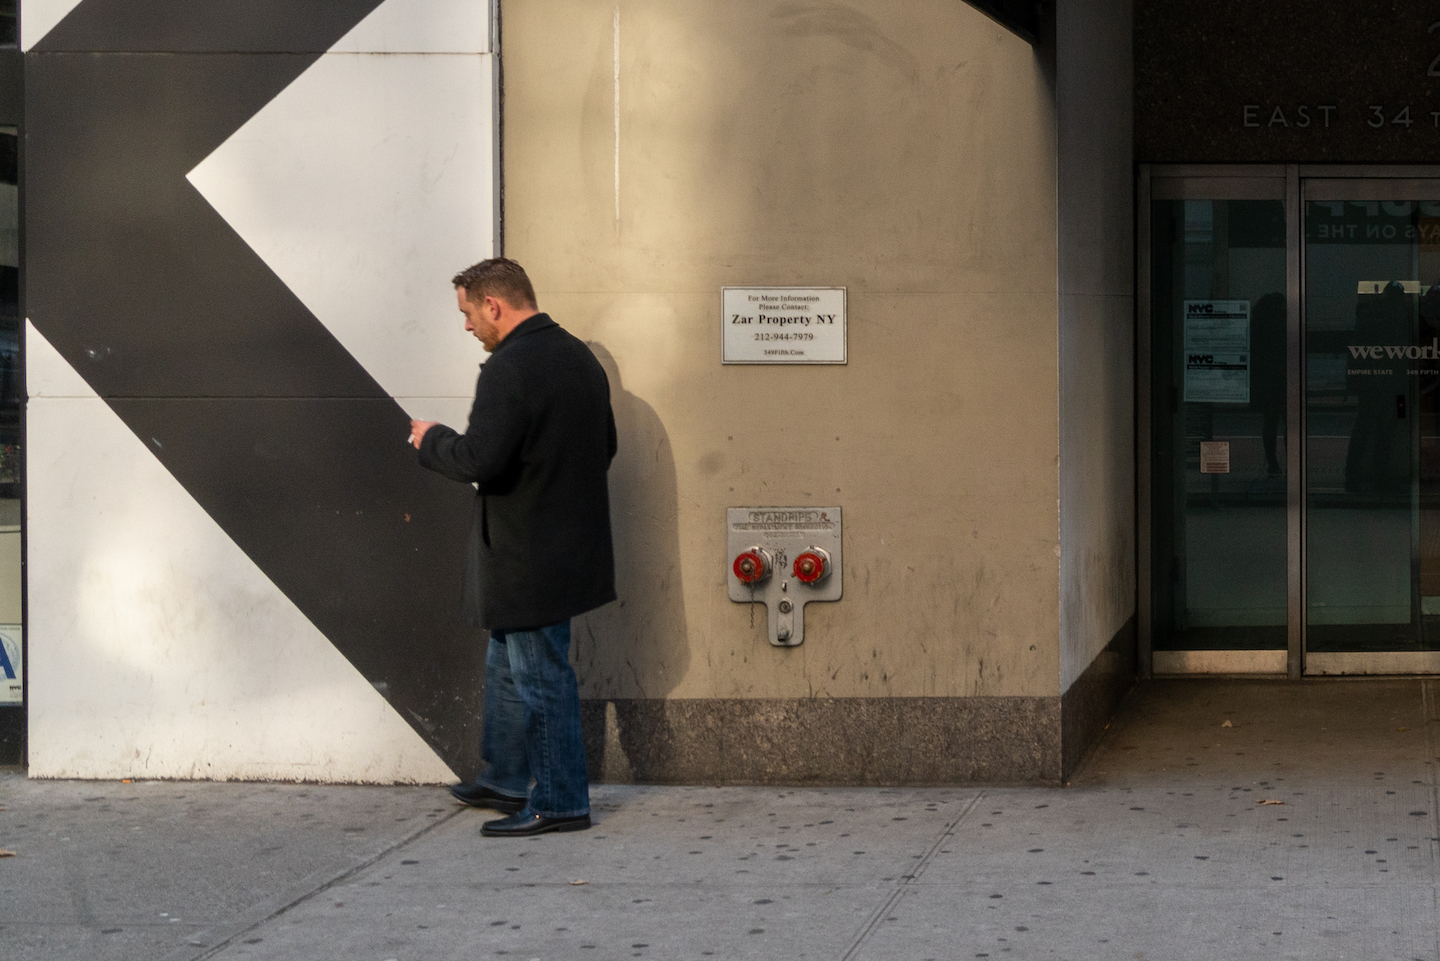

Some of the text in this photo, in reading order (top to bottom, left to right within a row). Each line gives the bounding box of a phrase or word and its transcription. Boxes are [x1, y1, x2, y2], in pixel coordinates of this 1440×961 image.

[1243, 105, 1337, 128] EAST
[1188, 304, 1214, 313] NYC
[732, 314, 836, 326] Zar Property NY
[754, 333, 814, 341] 212-944-7979
[1188, 355, 1214, 364] NYC
